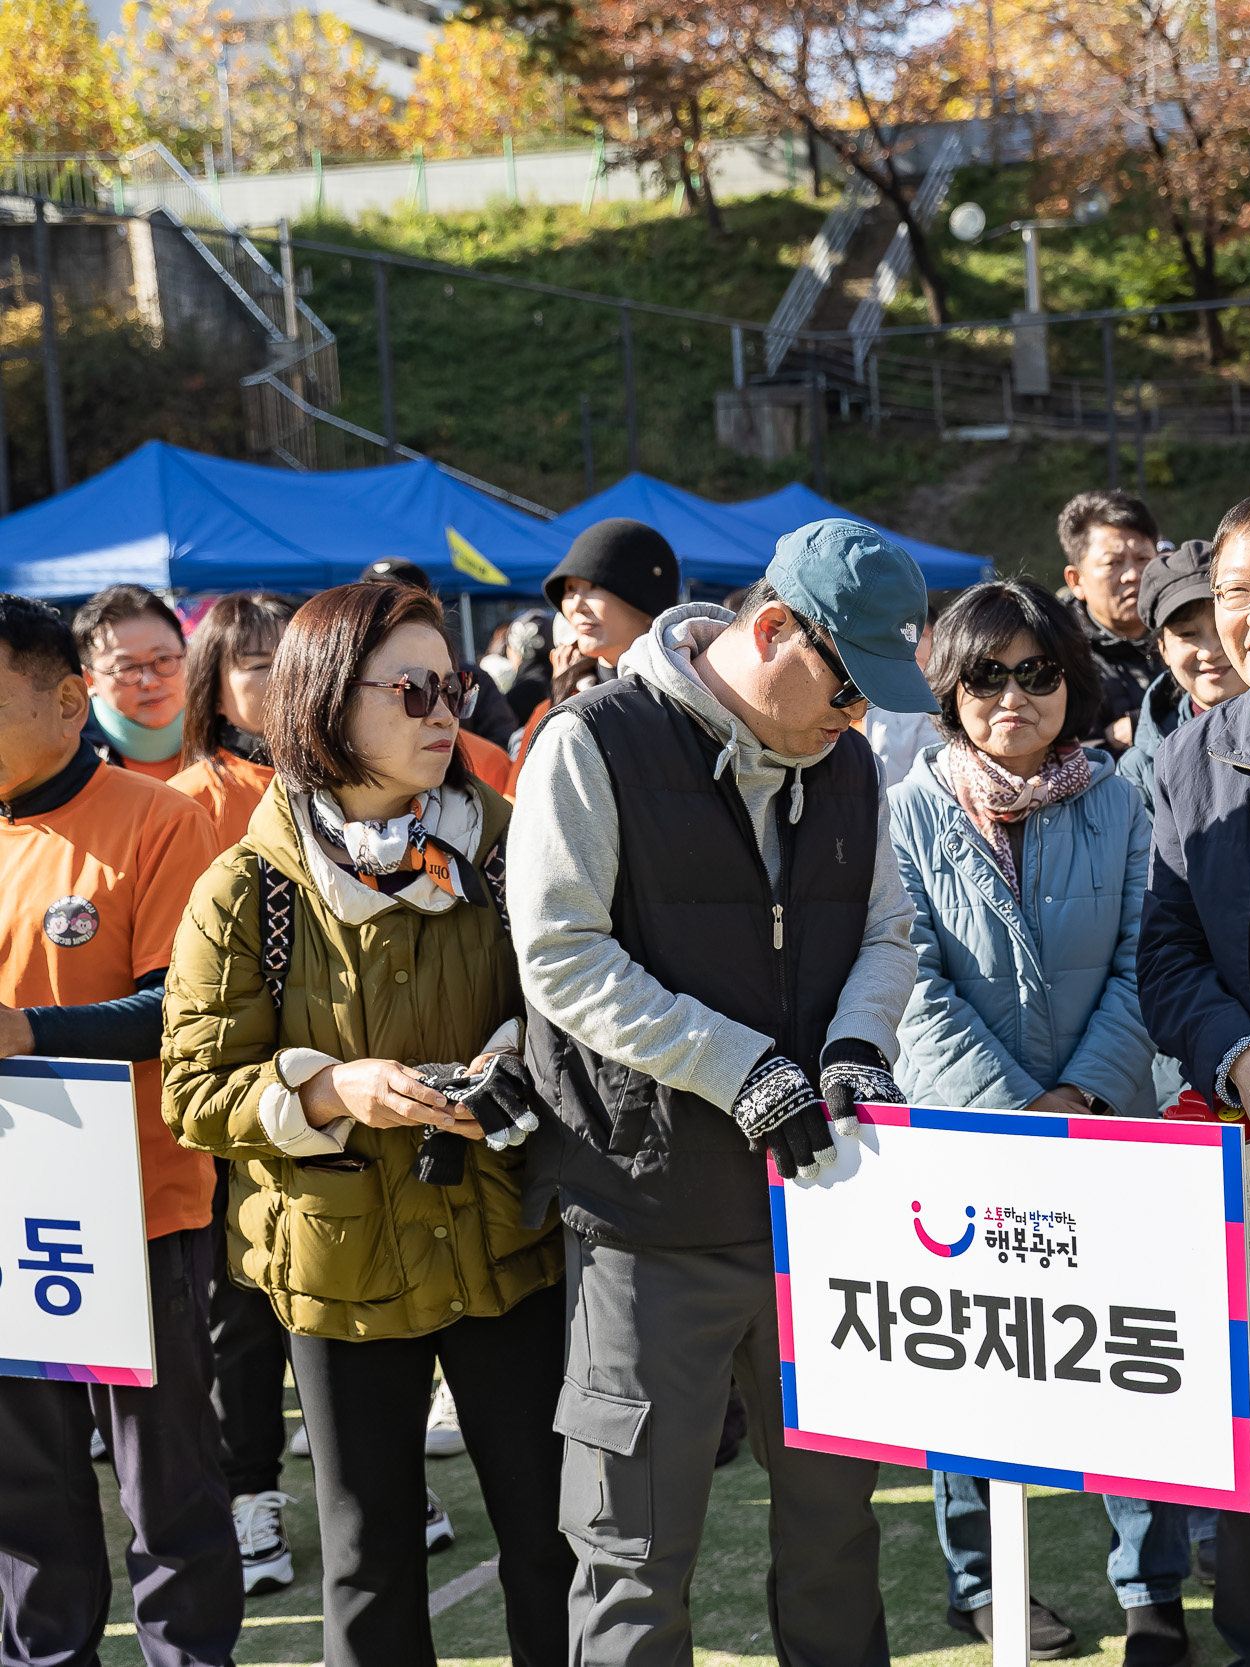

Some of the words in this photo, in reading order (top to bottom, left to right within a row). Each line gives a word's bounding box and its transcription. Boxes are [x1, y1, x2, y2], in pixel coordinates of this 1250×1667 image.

[984, 1207, 1026, 1228] 소통하며
[1030, 1210, 1076, 1232] 발전하는
[985, 1228, 1077, 1268] 행복광진
[0, 1217, 94, 1316] 동
[828, 1278, 1185, 1394] 자양제2동
